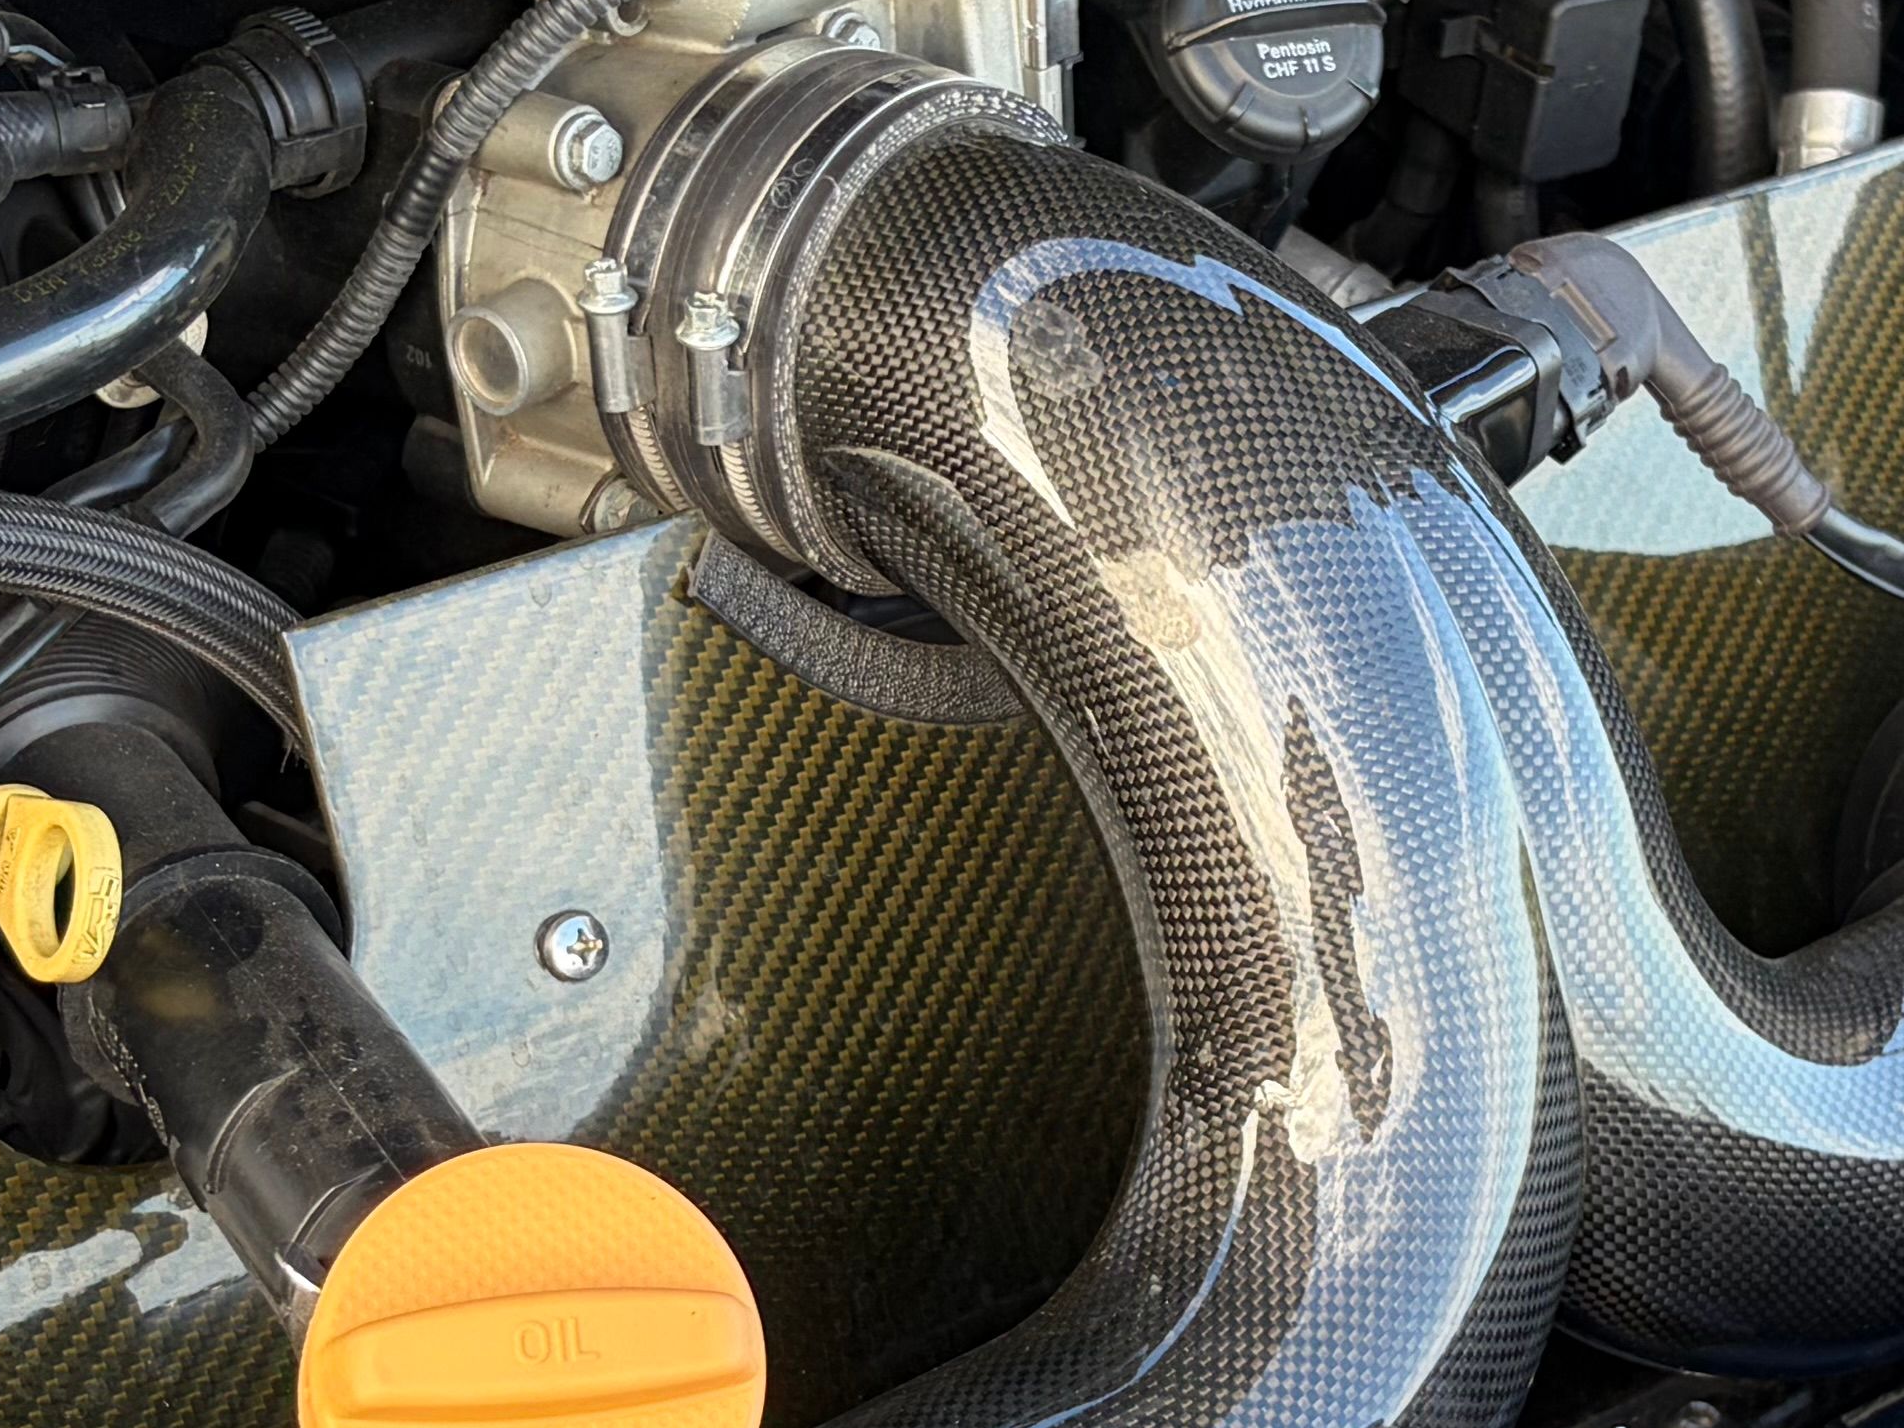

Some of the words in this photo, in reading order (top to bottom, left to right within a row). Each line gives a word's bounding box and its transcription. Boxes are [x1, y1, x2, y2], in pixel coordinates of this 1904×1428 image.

[1256, 39, 1331, 60] Pentosin
[1262, 60, 1299, 79] CHF
[1304, 57, 1321, 74] 11
[1321, 56, 1337, 72] S
[513, 1317, 602, 1366] OIL
